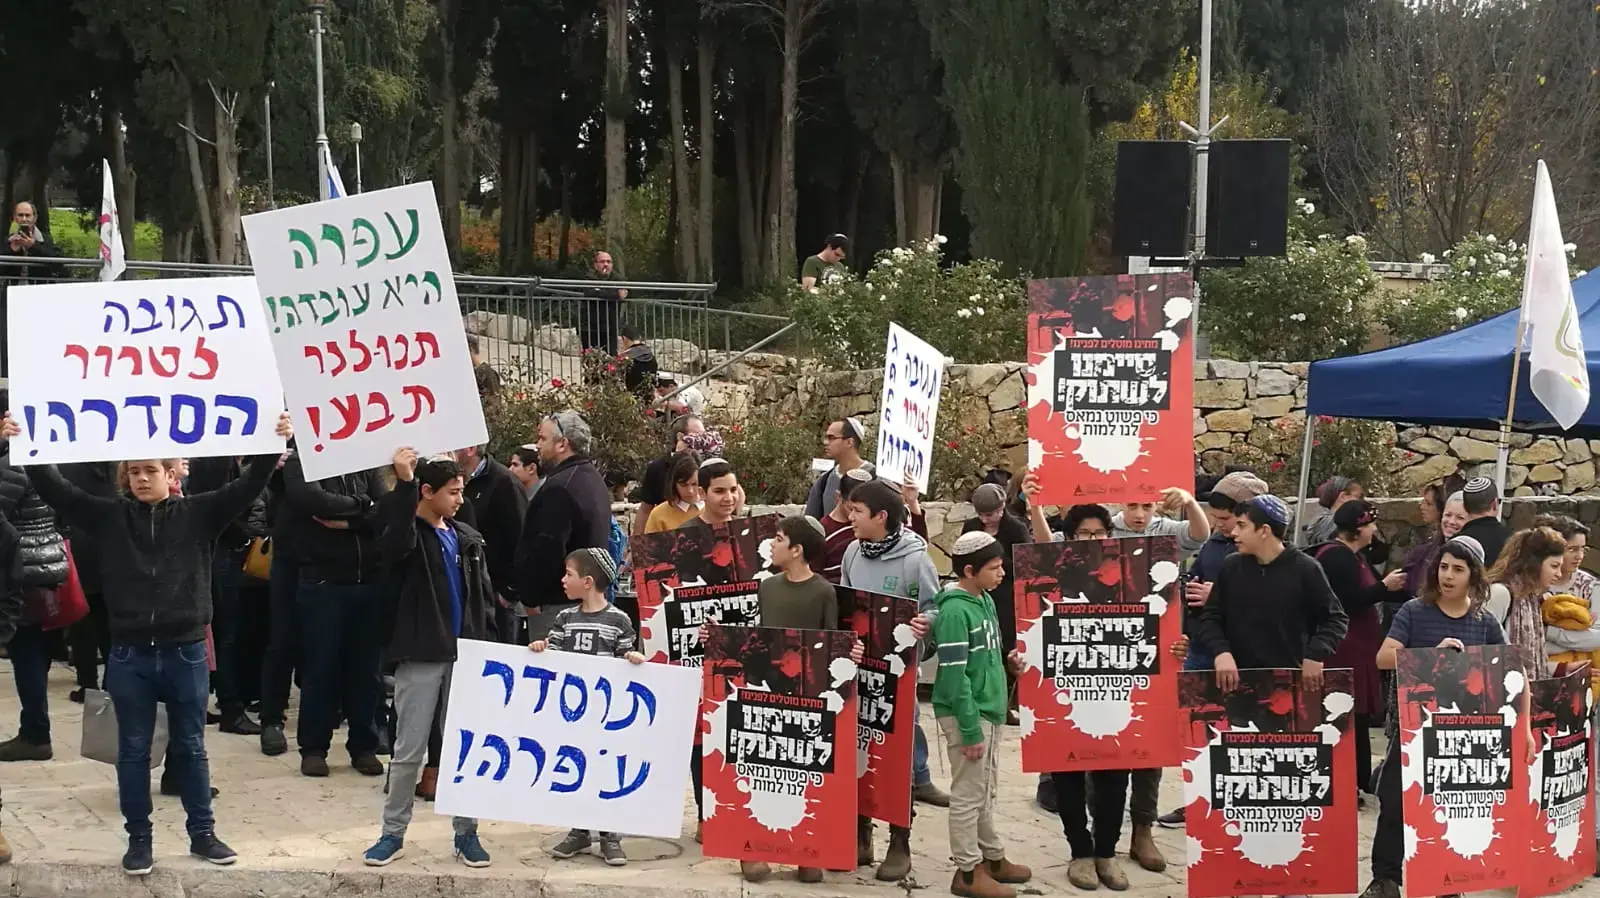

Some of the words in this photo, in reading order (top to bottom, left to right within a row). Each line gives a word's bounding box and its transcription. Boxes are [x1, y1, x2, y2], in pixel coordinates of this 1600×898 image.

[288, 209, 420, 269] עפרה
[383, 271, 442, 309] היא
[103, 294, 246, 334] תגובה
[266, 283, 370, 333] עובדה!
[64, 336, 219, 380] לטרור
[1071, 352, 1157, 378] סיימנו
[1057, 376, 1168, 410] לשתוק!
[1066, 410, 1100, 423] נמאס
[1102, 411, 1142, 424] פשוט
[1145, 411, 1158, 424] כי
[23, 393, 259, 457] הסדרה!
[1083, 423, 1116, 436] למות
[1120, 423, 1139, 436] לנו
[1058, 617, 1145, 642] סיימנו
[573, 632, 593, 650] 15
[1047, 639, 1157, 675] לשתוק!
[1056, 676, 1092, 688] נמאס
[1096, 676, 1133, 689] פשוט
[1136, 676, 1148, 688] כי
[482, 660, 657, 731] תוסדר
[1074, 688, 1107, 701] למות
[1111, 688, 1130, 701] לנו
[742, 704, 822, 737] סיימנו
[730, 728, 833, 766] לשתוק!
[1227, 747, 1317, 772] סיימנו
[737, 763, 770, 778] נמאס
[773, 768, 807, 784] פשוט
[752, 779, 783, 794] למות
[810, 773, 823, 786] כי
[787, 783, 805, 796] לנו
[1215, 769, 1330, 807] לשתוק!
[1226, 808, 1263, 819] נמאס
[1266, 808, 1304, 820] פשוט
[1308, 808, 1321, 820] כי
[1449, 806, 1474, 819] למות
[1477, 806, 1492, 818] לנו
[1243, 821, 1278, 833] למות
[1283, 821, 1301, 833] לנו
